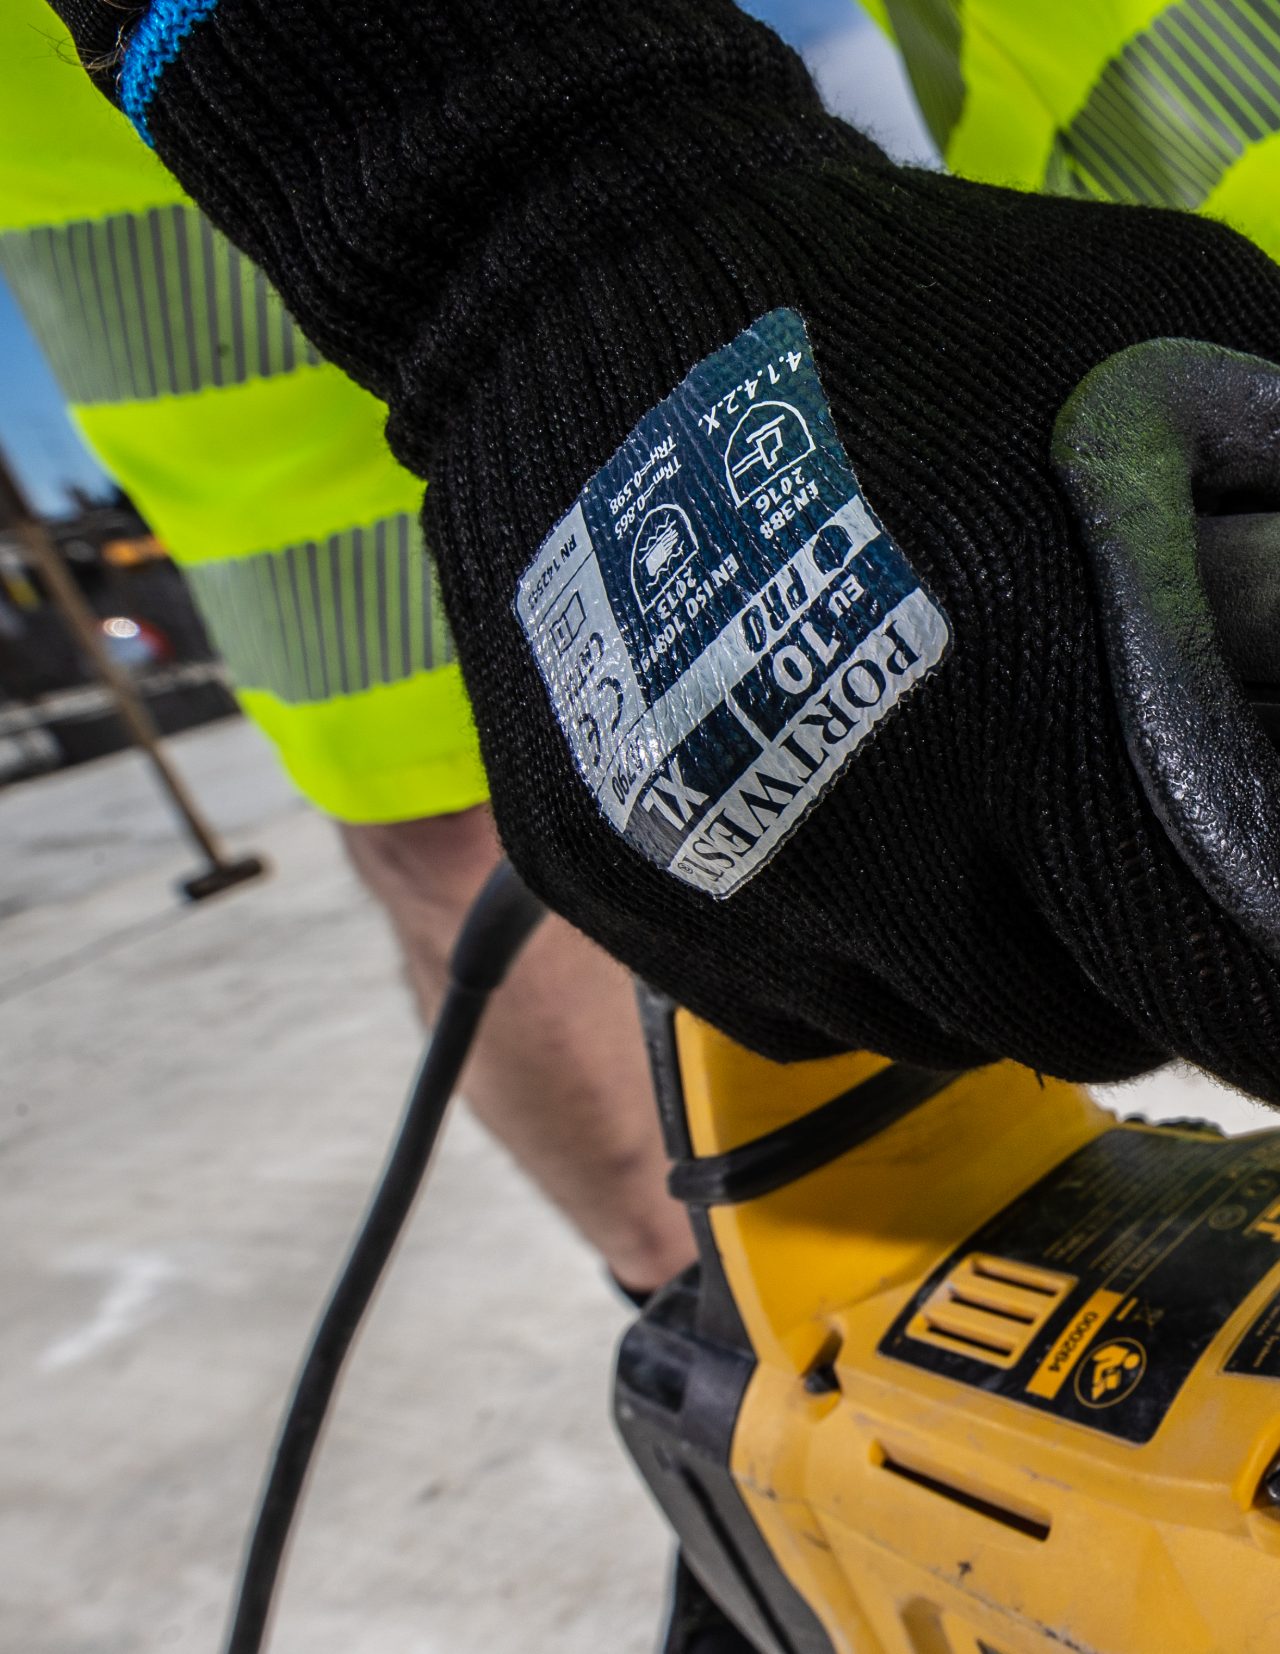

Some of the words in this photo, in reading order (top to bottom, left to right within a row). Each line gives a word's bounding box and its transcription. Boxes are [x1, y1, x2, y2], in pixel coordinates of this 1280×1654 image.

[755, 466, 805, 515] 2016
[560, 533, 577, 562] RN
[711, 552, 740, 588] EN
[657, 567, 697, 620] 2013
[685, 579, 714, 620] ISO
[741, 560, 813, 654] PRO
[829, 574, 865, 618] EU
[640, 619, 686, 672] 10819
[773, 621, 841, 695] 10
[642, 756, 711, 831] XL
